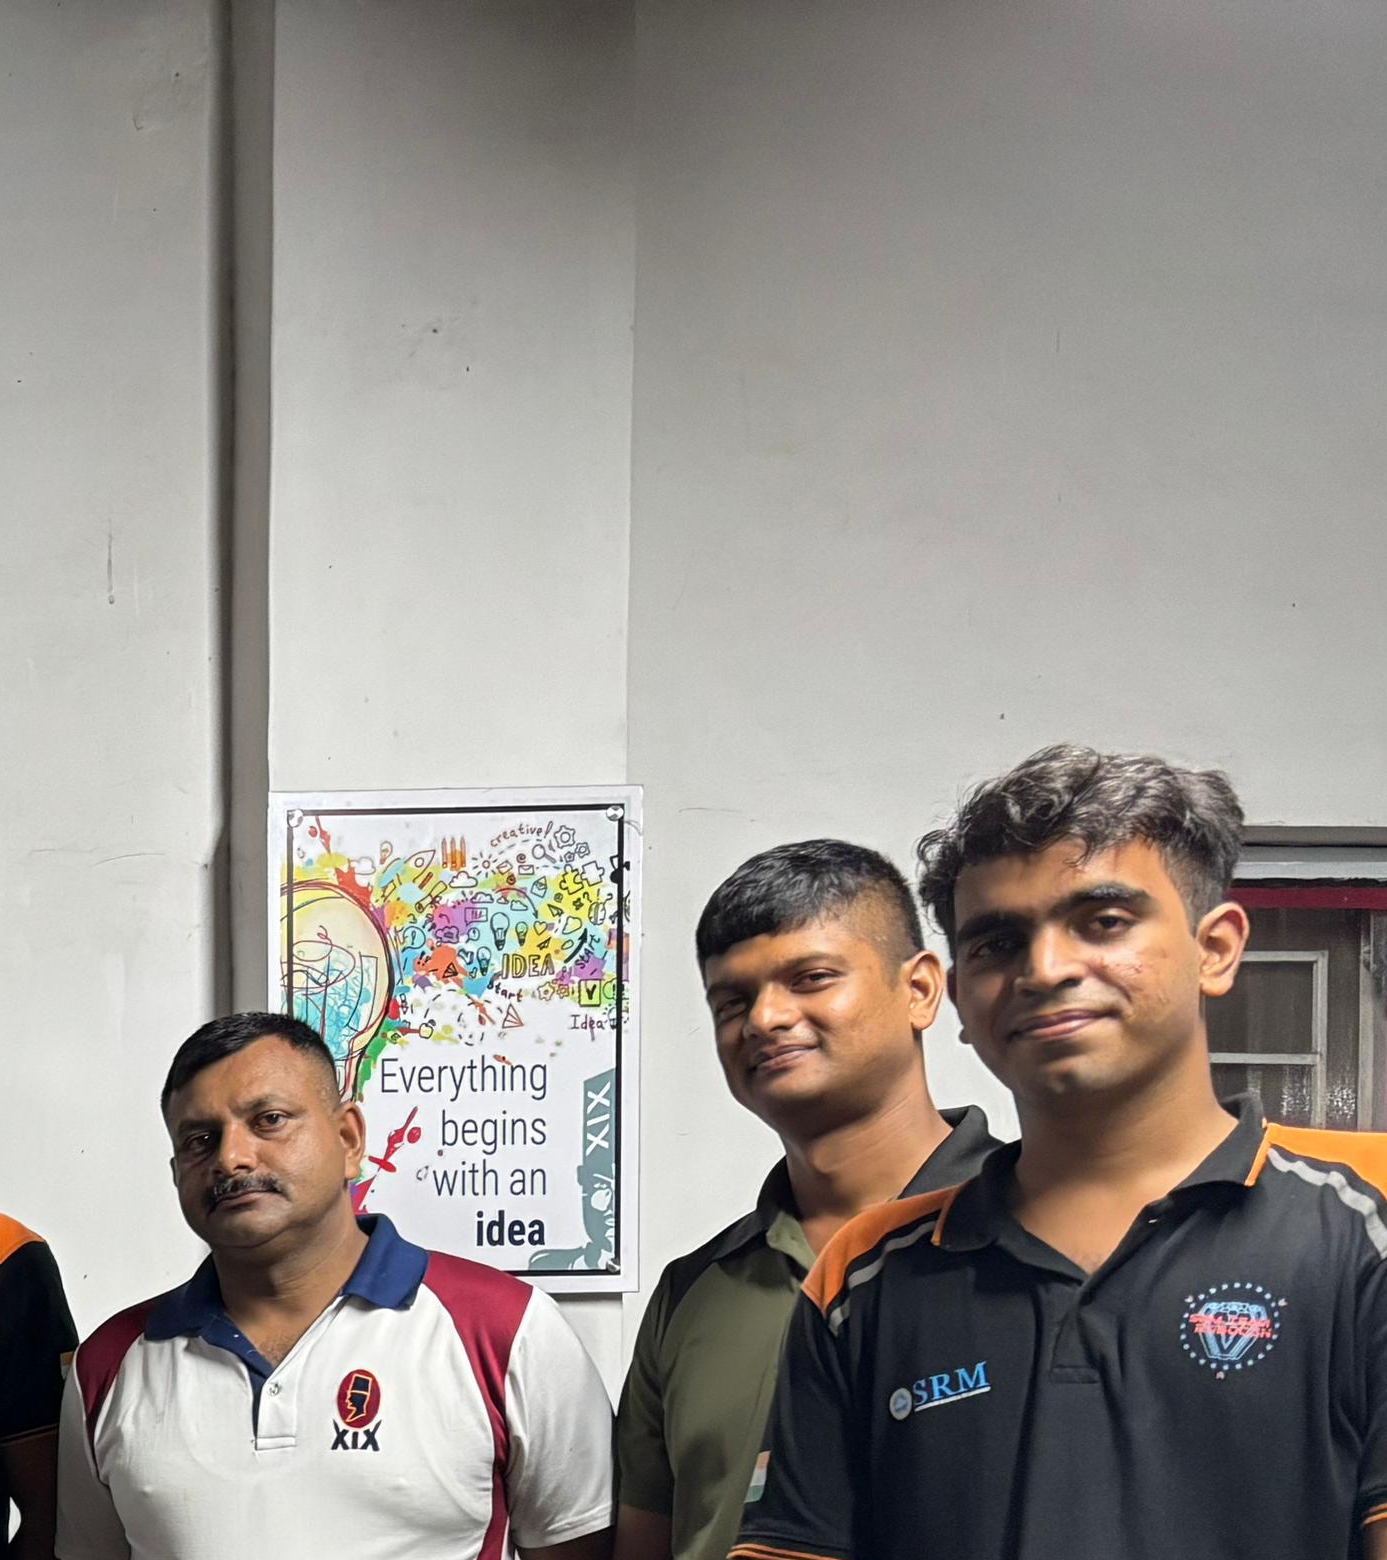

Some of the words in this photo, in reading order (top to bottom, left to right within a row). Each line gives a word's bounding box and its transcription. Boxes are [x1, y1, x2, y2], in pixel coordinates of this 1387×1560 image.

[490, 821, 554, 848] creative!
[501, 954, 555, 979] IDEA
[570, 1014, 605, 1030] Idea
[381, 1055, 547, 1101] Everything
[442, 1109, 547, 1155] begins
[586, 1081, 611, 1156] XIX
[433, 1159, 499, 1197] with
[510, 1167, 547, 1196] an
[476, 1210, 546, 1247] idea
[913, 1361, 990, 1407] SRM
[331, 1419, 382, 1452] XIX
